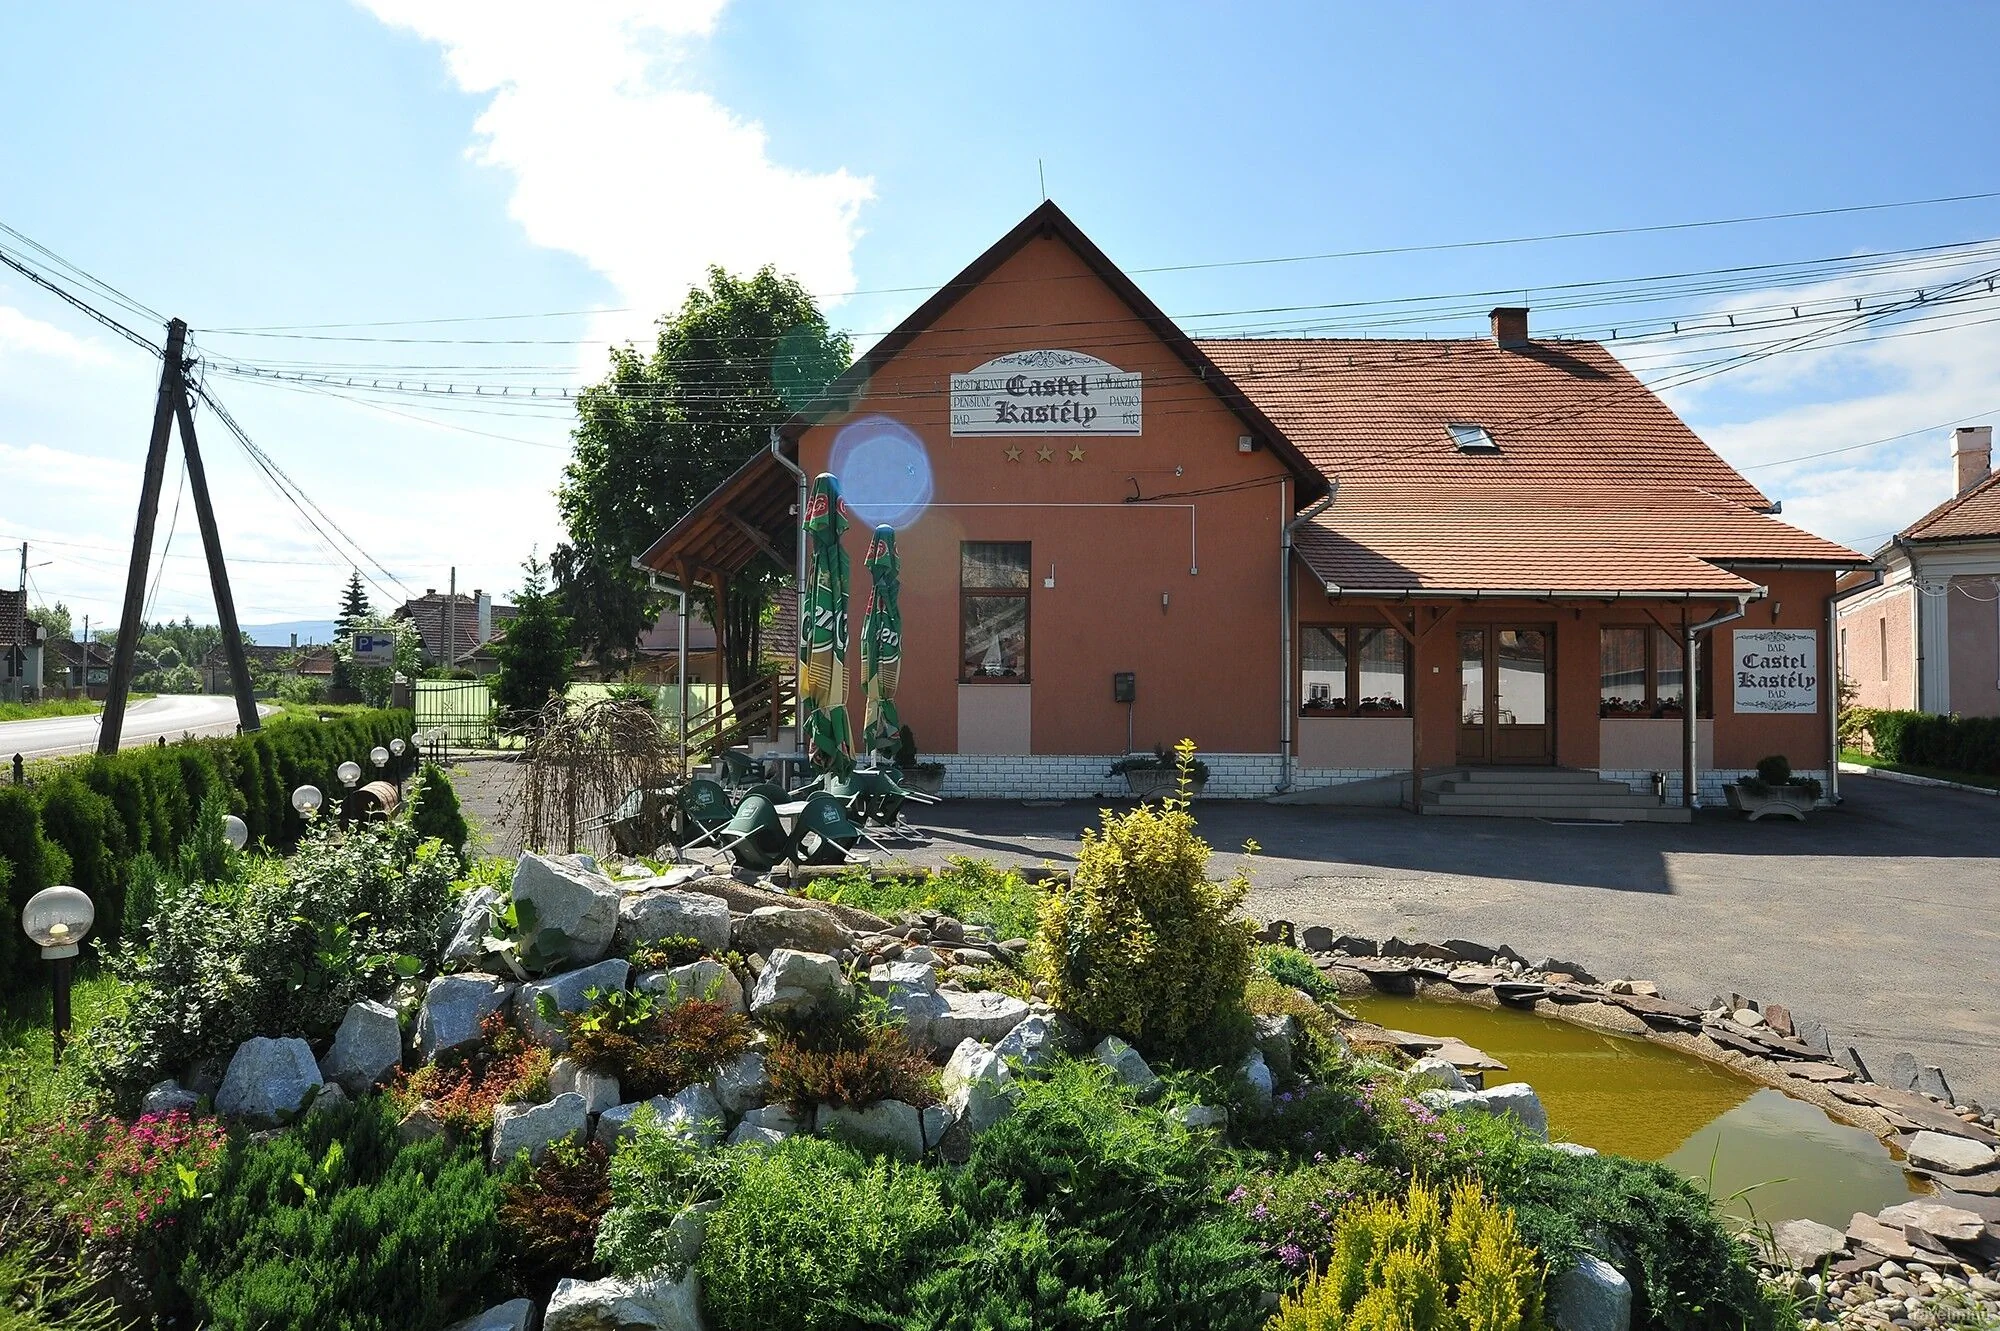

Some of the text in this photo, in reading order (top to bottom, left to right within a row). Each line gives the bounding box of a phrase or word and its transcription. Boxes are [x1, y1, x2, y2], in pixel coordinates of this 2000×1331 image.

[1005, 374, 1091, 397] Castel
[953, 396, 991, 408] PENSIUNE
[953, 414, 970, 425] BAR
[994, 400, 1098, 429] Kastély
[1767, 643, 1786, 652] BAR
[1742, 653, 1807, 669] Castel
[1737, 671, 1816, 692] Kastély
